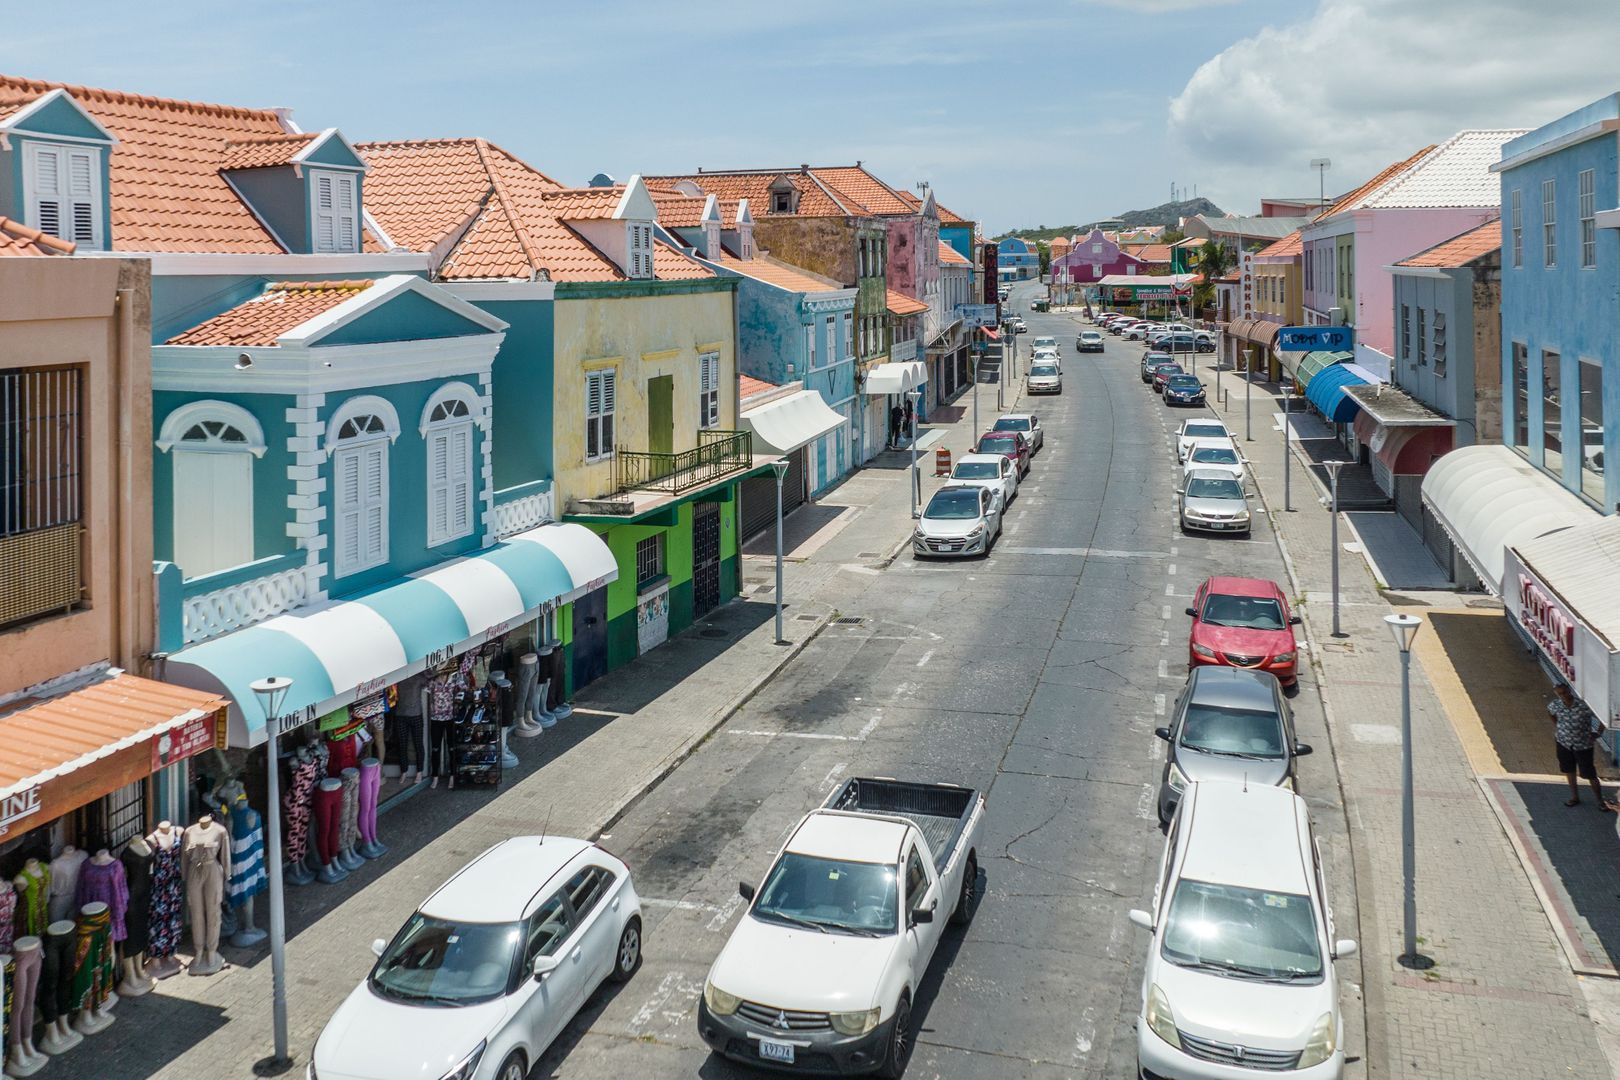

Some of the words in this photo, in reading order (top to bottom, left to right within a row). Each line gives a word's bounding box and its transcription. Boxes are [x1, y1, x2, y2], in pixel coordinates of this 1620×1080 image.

[1244, 255, 1252, 320] ALANKAR
[555, 594, 562, 609] IN
[447, 643, 454, 658] IN
[355, 678, 386, 700] Fashion
[306, 702, 317, 719] IN
